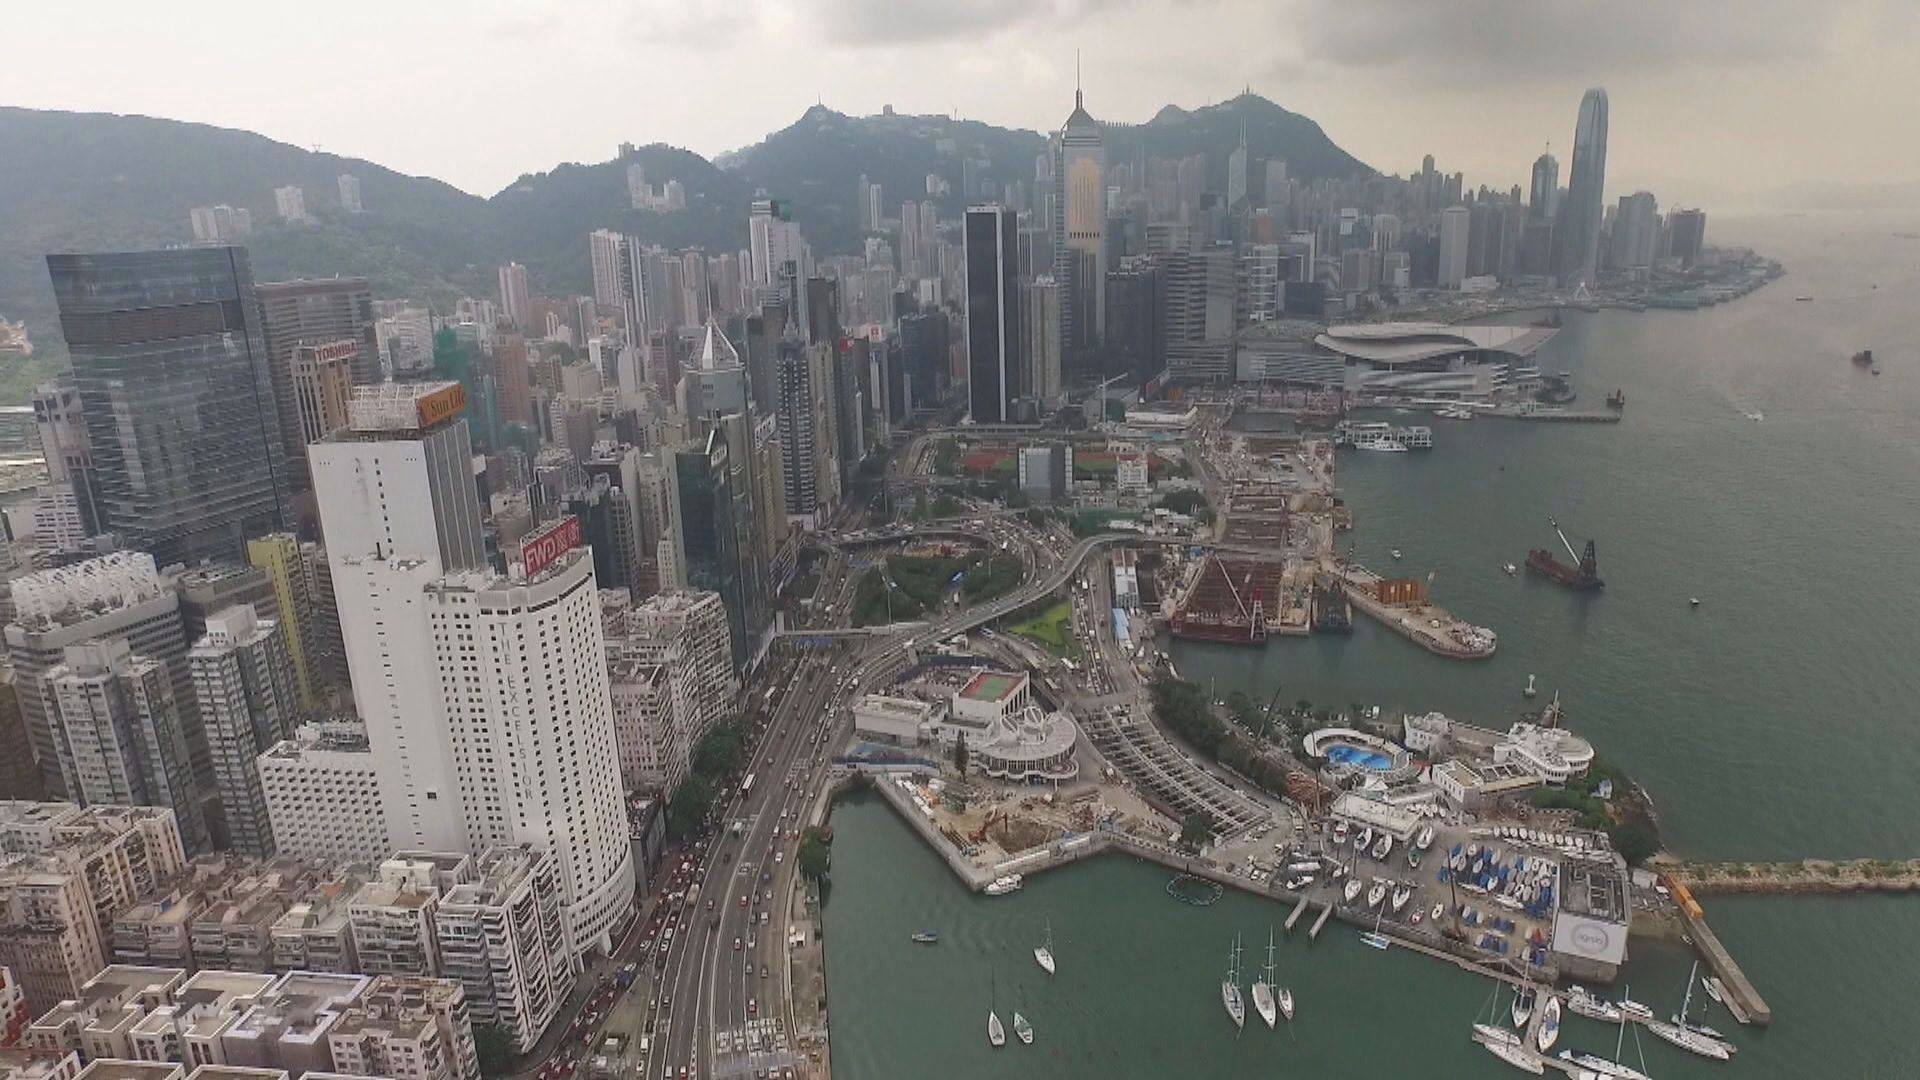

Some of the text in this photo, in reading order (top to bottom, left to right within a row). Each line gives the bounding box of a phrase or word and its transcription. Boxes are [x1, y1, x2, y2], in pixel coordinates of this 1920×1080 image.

[316, 341, 357, 361] TOSHIBA
[431, 399, 449, 416] Sun
[525, 537, 556, 574] FWD
[497, 622, 533, 800] THE EXCELSIOR
